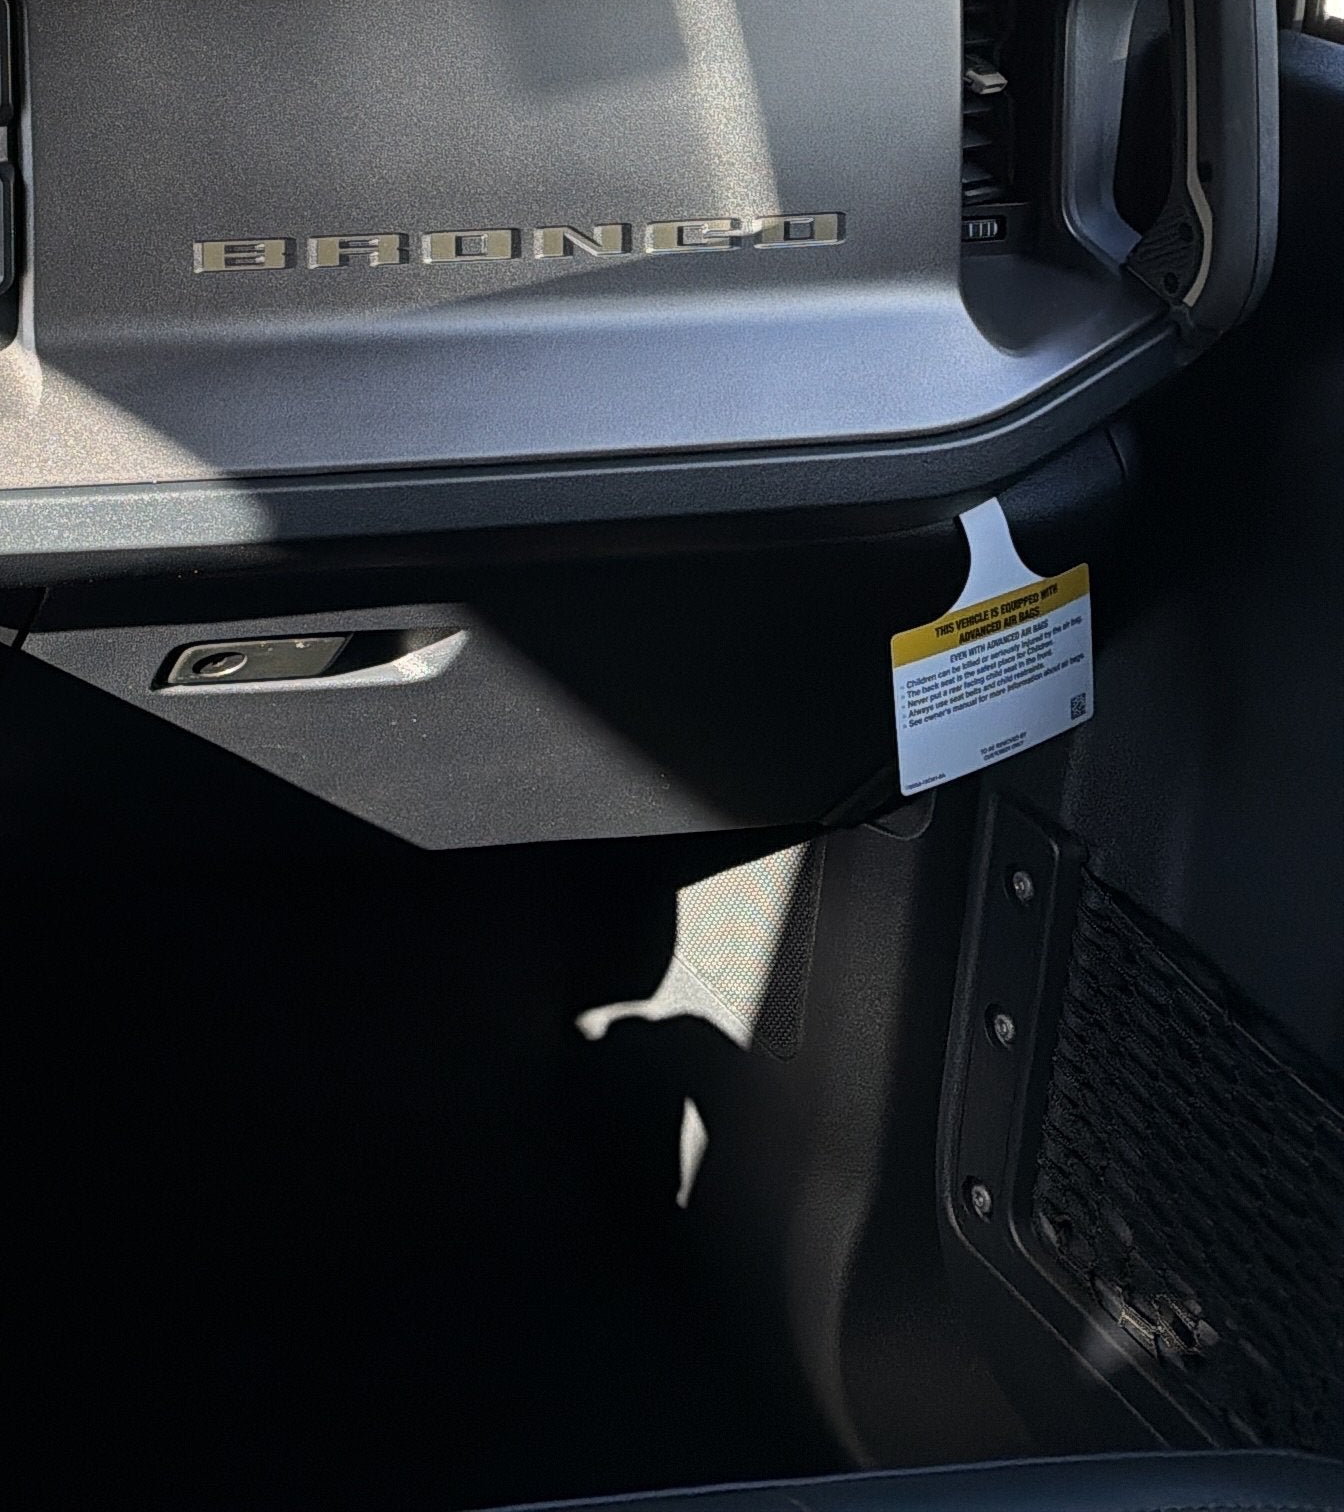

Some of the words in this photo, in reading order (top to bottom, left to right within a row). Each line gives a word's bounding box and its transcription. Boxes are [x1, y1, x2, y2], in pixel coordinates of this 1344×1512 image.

[193, 211, 845, 273] BRONCO
[935, 622, 954, 637] THIS
[956, 610, 988, 629] VEHICLE
[990, 606, 998, 618] IS
[1000, 592, 1039, 613] EQUIPPED
[1040, 583, 1057, 599] WITH
[959, 621, 1000, 642] ADVANCED
[1004, 614, 1016, 627] AIR
[1019, 605, 1039, 622] BAGS
[906, 672, 935, 688] Children
[937, 669, 950, 678] can
[951, 664, 959, 673] be
[962, 657, 979, 669] killed
[990, 643, 1019, 659] seriously
[1021, 633, 1042, 648] injured
[1044, 629, 1051, 639] by
[950, 650, 966, 662] EVEN
[968, 643, 985, 656] WITH
[987, 632, 1019, 648] ADVANCED
[1021, 625, 1031, 637] AIR
[1033, 618, 1048, 632] BAGS
[907, 687, 920, 698] The
[922, 681, 938, 693] back
[941, 677, 954, 686] seat
[957, 673, 962, 681] is
[964, 669, 974, 678] the
[976, 662, 995, 674] safest
[998, 655, 1015, 666] place
[1016, 650, 1025, 658] for
[907, 694, 928, 707] Never
[930, 691, 941, 701] put
[949, 685, 961, 693] rear
[964, 675, 984, 689] facing
[985, 669, 1002, 680] child
[1004, 664, 1016, 673] seat
[1018, 660, 1024, 668] in
[1025, 655, 1035, 664] the
[908, 703, 933, 718] Always
[935, 700, 947, 708] use
[950, 693, 963, 703] seat
[965, 686, 981, 697] belts
[983, 681, 995, 691] and
[997, 675, 1012, 685] child
[909, 716, 921, 727] See
[924, 708, 950, 722] owner's
[953, 698, 976, 711] manual
[978, 693, 987, 702] for
[989, 688, 1005, 698] more
[1007, 673, 1042, 690] information
[1043, 664, 1059, 676] about
